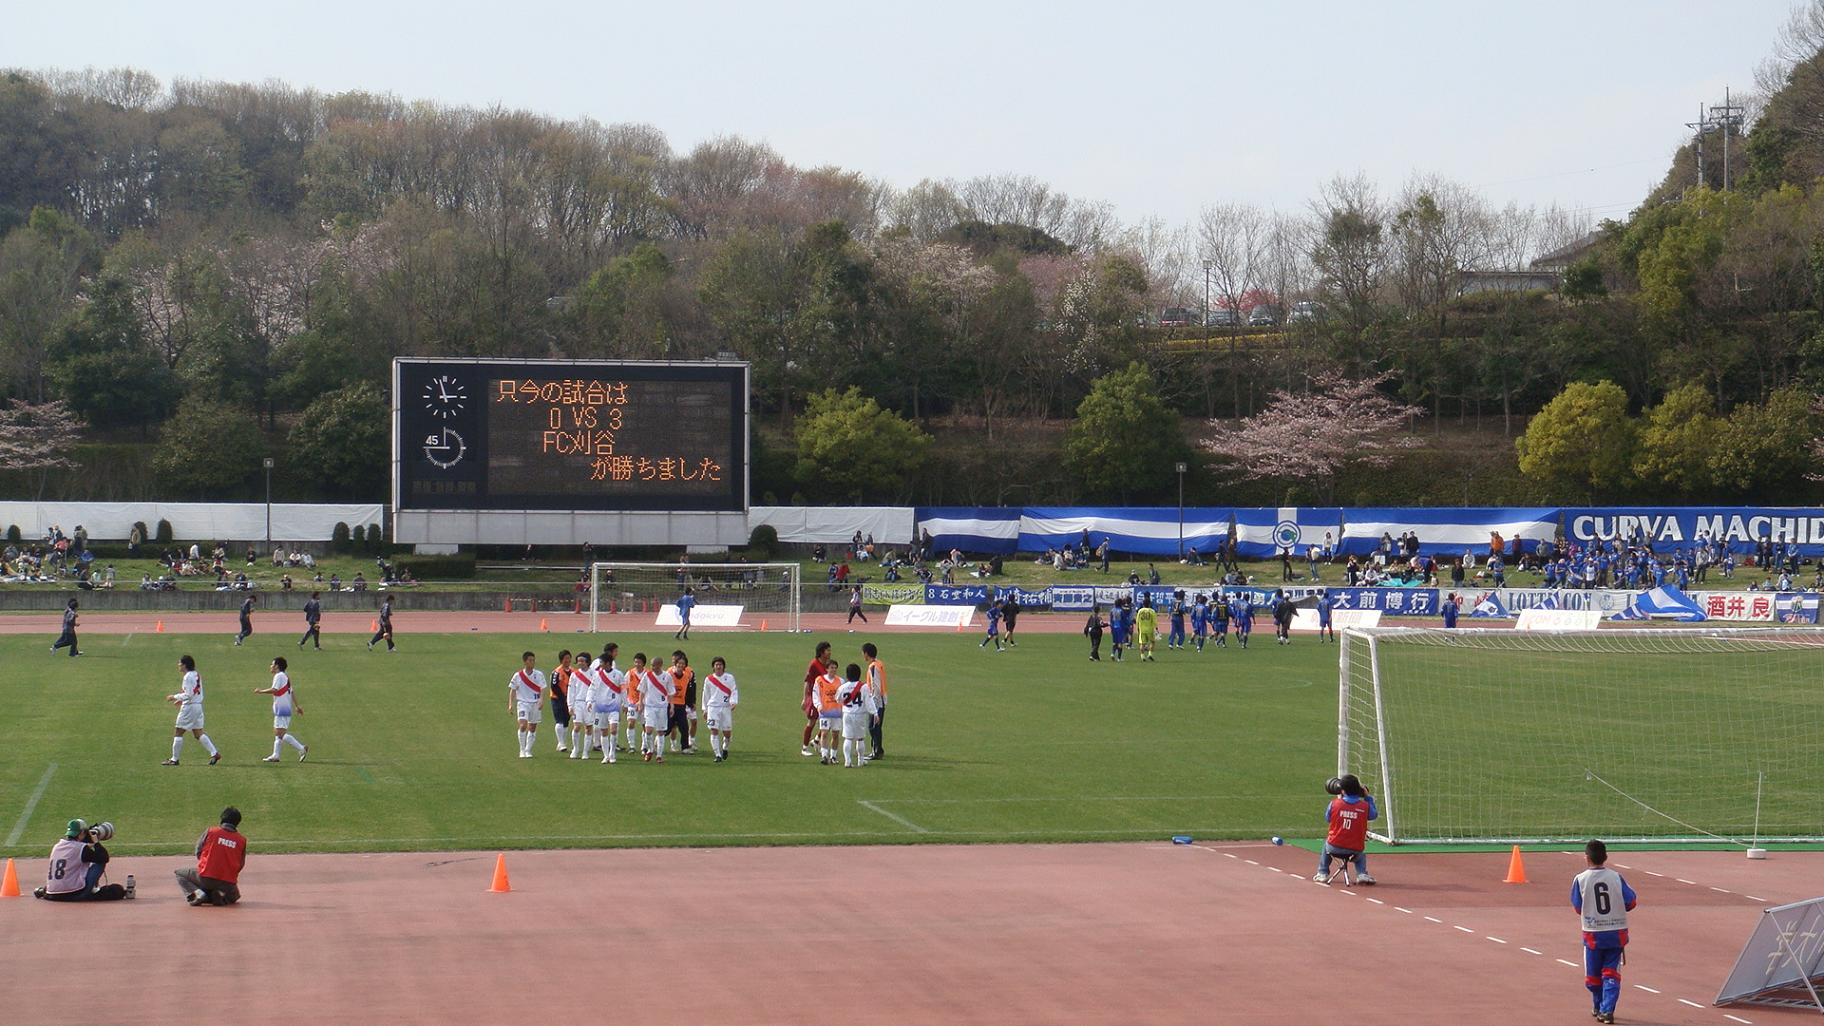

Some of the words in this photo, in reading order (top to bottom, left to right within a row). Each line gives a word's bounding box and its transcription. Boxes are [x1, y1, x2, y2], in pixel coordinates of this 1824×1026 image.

[497, 379, 629, 405] 只今の試合は
[550, 407, 561, 429] 0
[573, 407, 597, 429] VS
[609, 408, 622, 430] 3
[425, 434, 438, 445] 45
[544, 431, 615, 455] FC刈谷
[591, 458, 721, 481] が勝ちました
[1573, 515, 1683, 541] CURVA
[928, 588, 935, 599] 8
[1333, 591, 1430, 610] 大前博行
[1707, 595, 1770, 618] 酒井良
[843, 691, 863, 708] 24
[1339, 810, 1358, 819] PRESS
[1342, 819, 1352, 829] 10
[218, 837, 237, 849] PRESS
[48, 859, 67, 880] 18
[1593, 882, 1611, 915] 6
